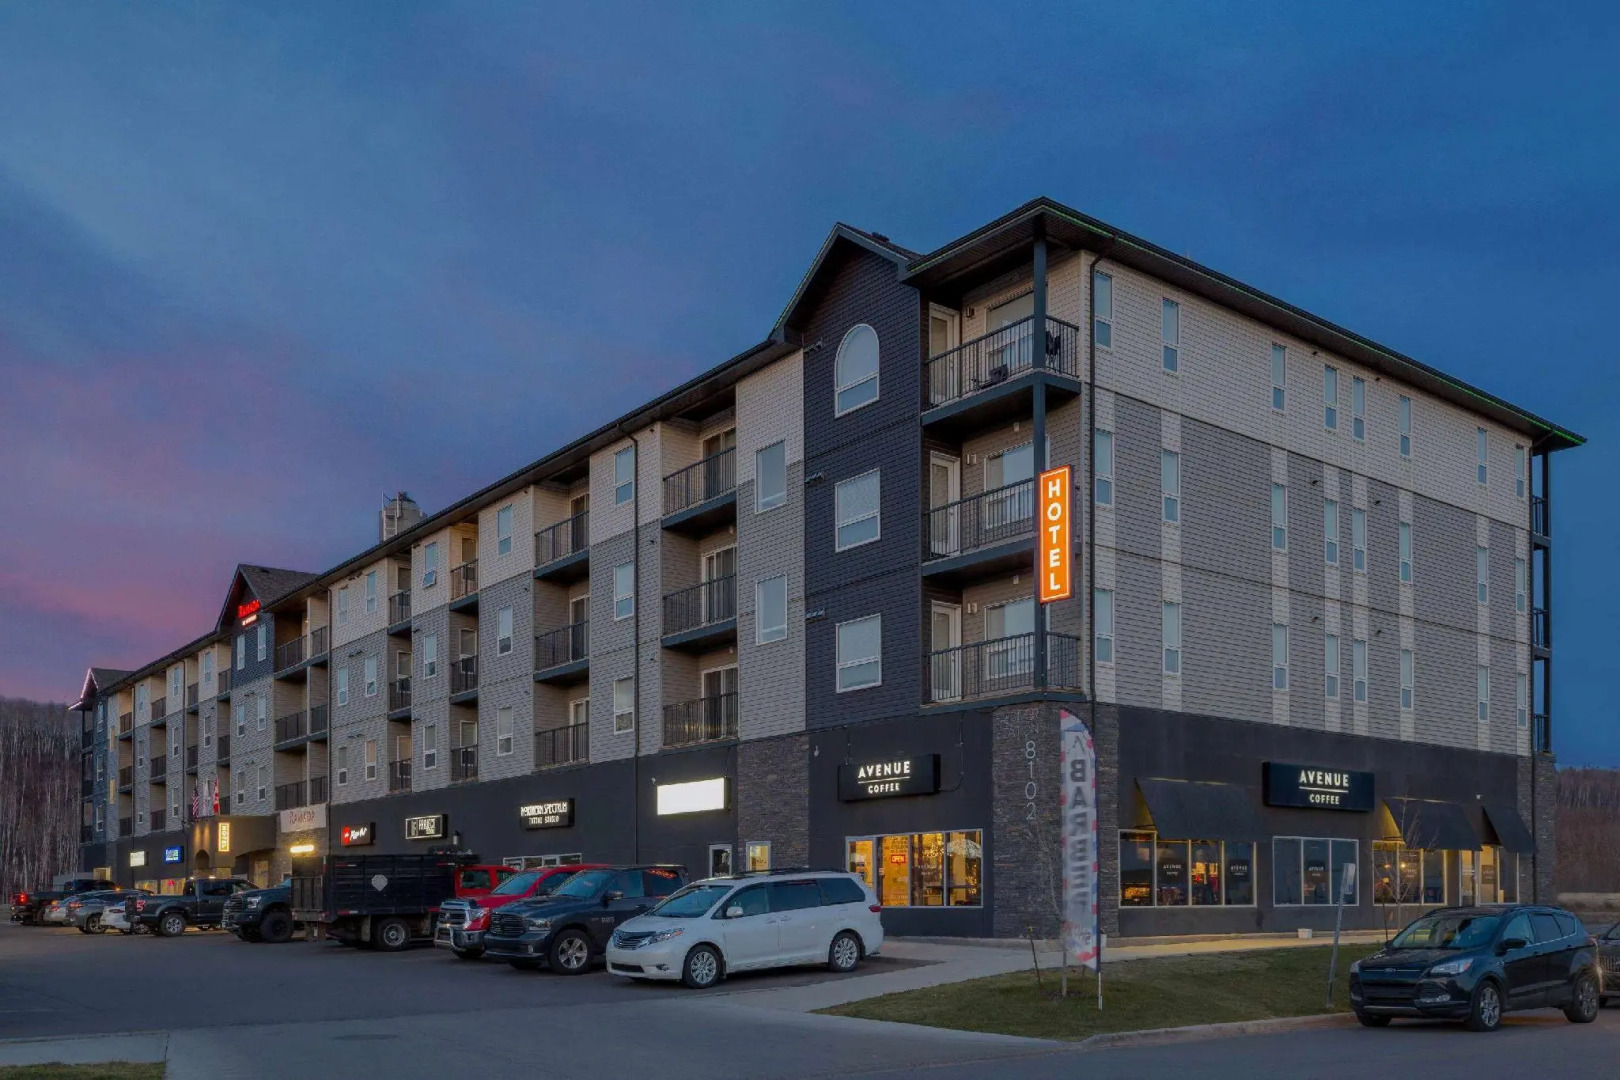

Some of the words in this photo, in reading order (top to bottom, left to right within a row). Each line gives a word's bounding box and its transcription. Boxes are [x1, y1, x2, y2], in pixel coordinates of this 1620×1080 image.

[1046, 478, 1062, 591] HOTEL
[858, 761, 911, 779] AVENUE
[1299, 769, 1349, 787] AVENUE
[868, 783, 900, 794] COFFEE
[1025, 741, 1037, 820] 8102
[1309, 793, 1340, 805] COFFEE
[891, 855, 905, 863] OPEN
